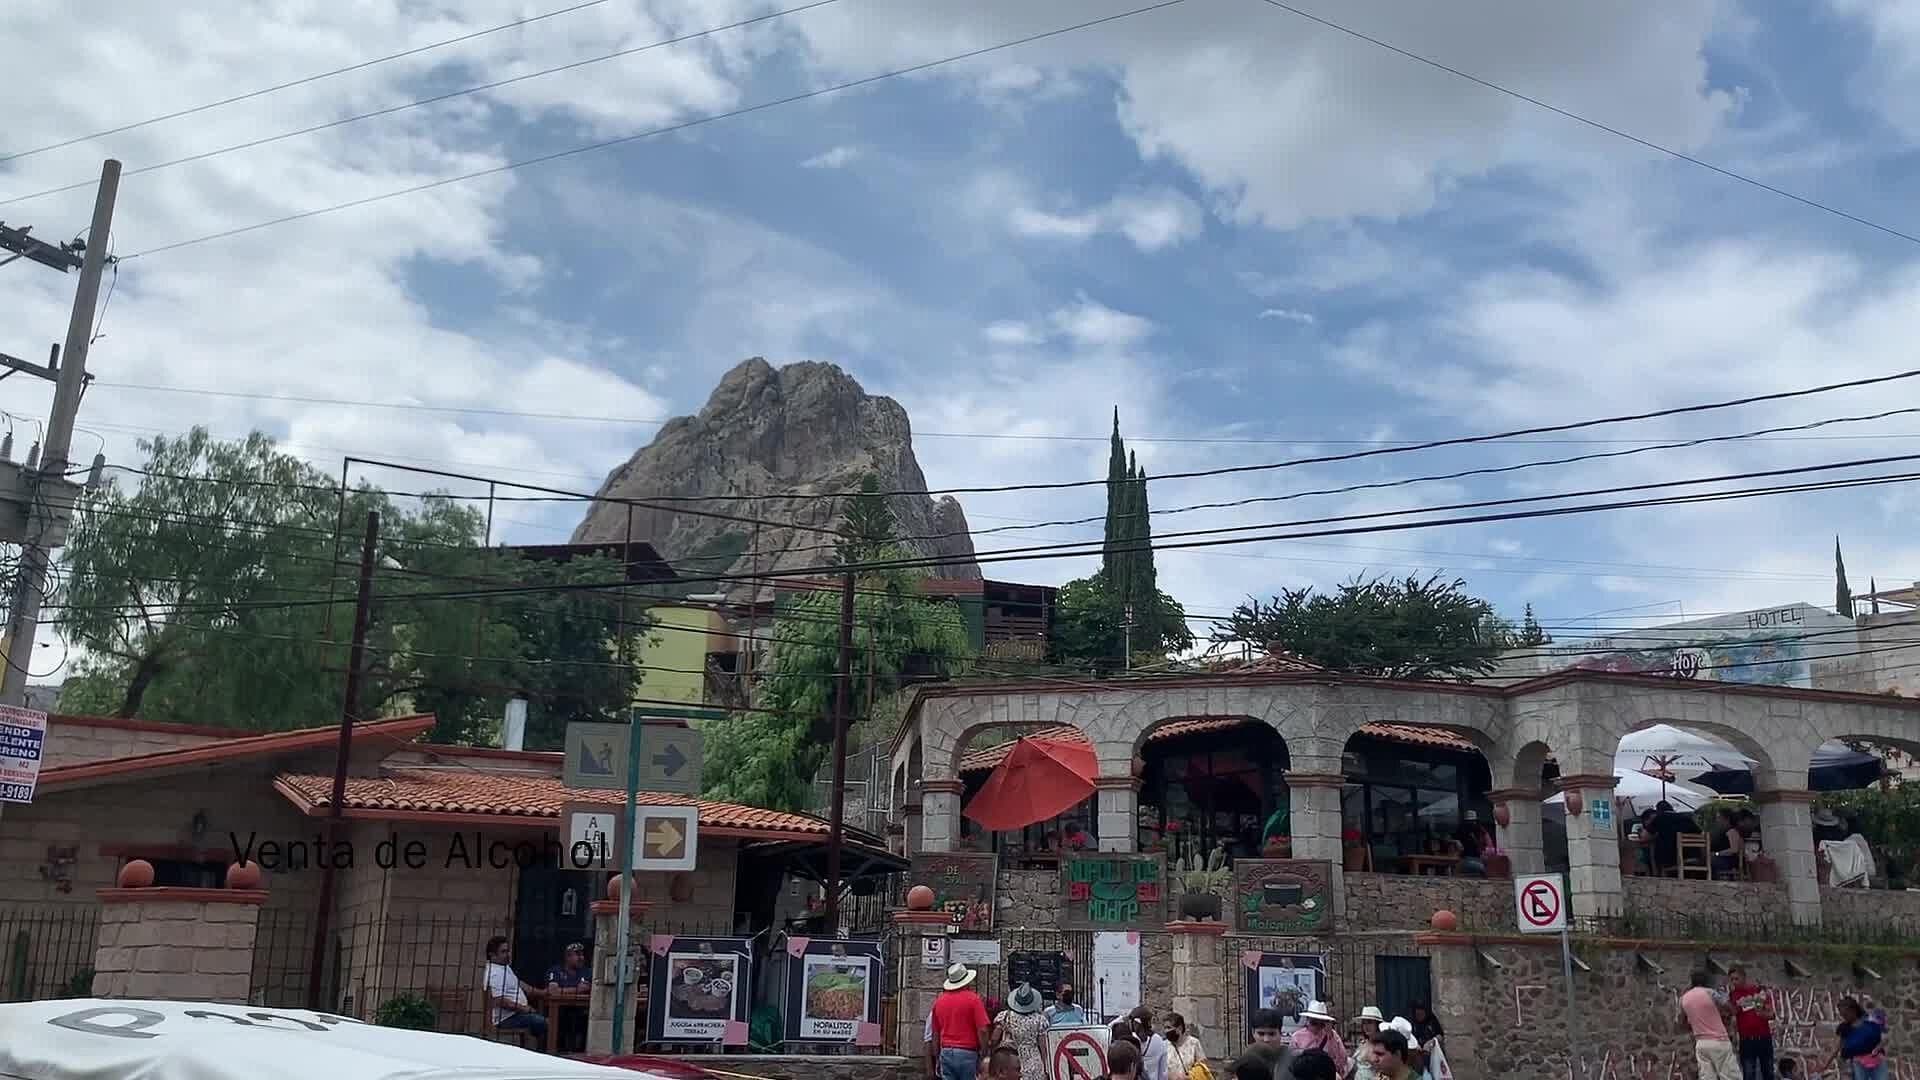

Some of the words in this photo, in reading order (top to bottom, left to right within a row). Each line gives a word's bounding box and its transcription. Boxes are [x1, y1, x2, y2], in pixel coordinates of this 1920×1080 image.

[1746, 608, 1801, 629] HOTEL
[589, 816, 598, 829] A
[585, 830, 601, 841] LA
[813, 1021, 853, 1030] NOPALITOS
